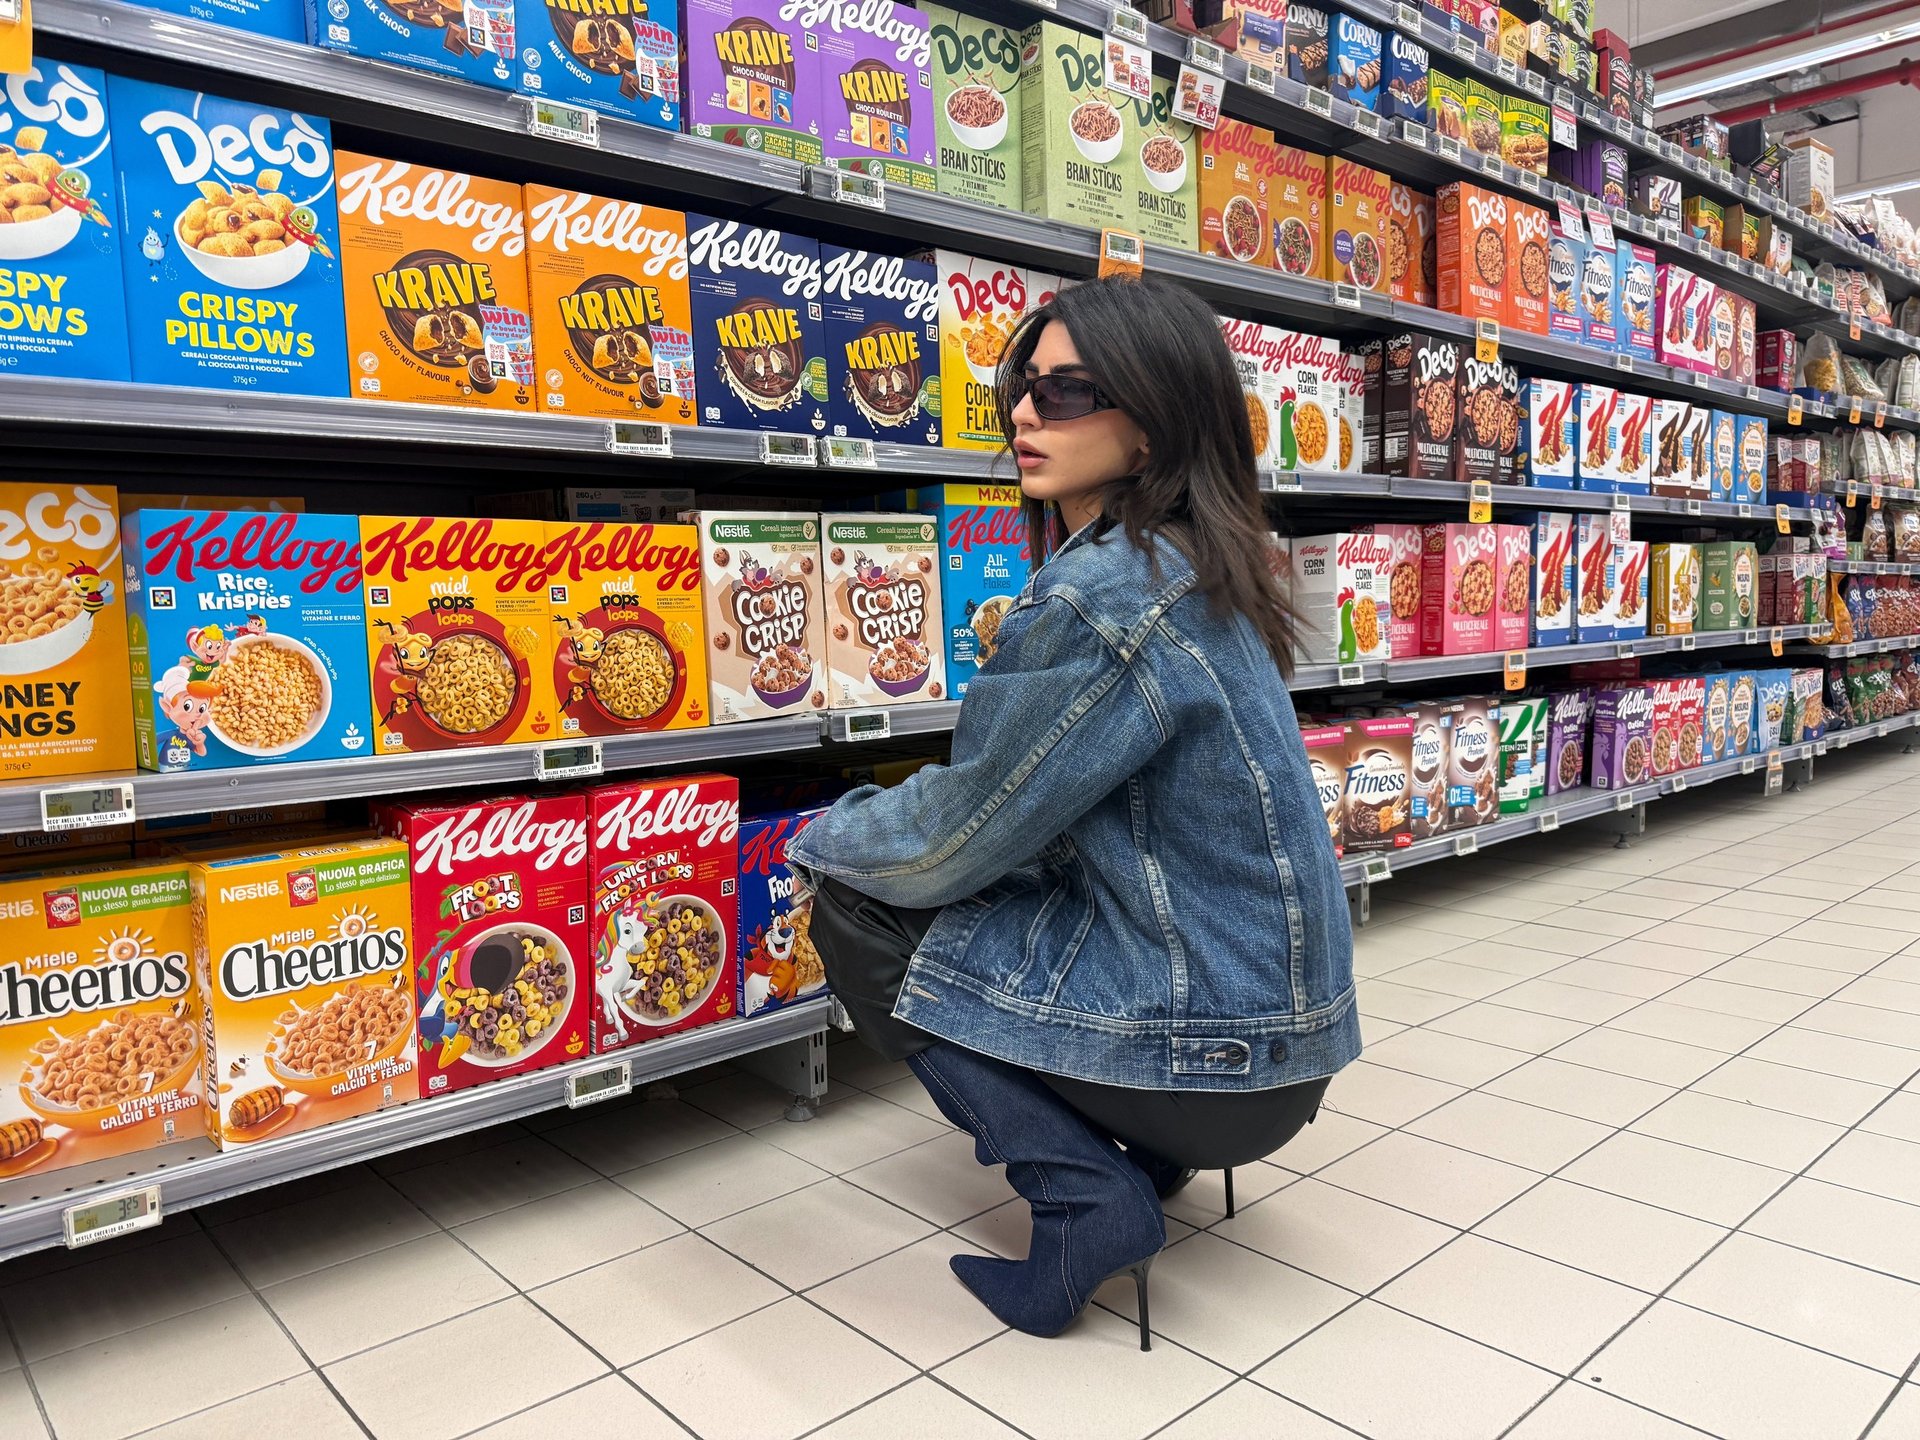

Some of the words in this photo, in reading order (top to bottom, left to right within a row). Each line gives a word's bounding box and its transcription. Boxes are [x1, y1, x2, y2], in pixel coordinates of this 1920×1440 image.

[1338, 16, 1380, 46] CORNY
[714, 29, 795, 66] KRAVE
[930, 24, 1020, 75] Decò
[1392, 33, 1427, 60] CORNY
[839, 70, 910, 103] KRAVE
[1506, 96, 1527, 112] NATURE
[1528, 103, 1548, 120] VALLEY
[140, 110, 330, 185] Decò
[941, 147, 969, 173] BRAN
[971, 153, 1006, 181] STICKS
[1066, 161, 1095, 184] BRAN
[1096, 166, 1122, 192] STICKS
[1234, 171, 1251, 183] Bran
[1283, 192, 1299, 204] Bran
[1334, 162, 1392, 216] Kellogg
[339, 161, 526, 257] Kellogg
[1138, 191, 1159, 213] BRAN
[1160, 194, 1187, 219] STICKS
[1467, 194, 1507, 230] Decò
[530, 194, 688, 281] Kellogg
[1514, 209, 1549, 244] Decò
[689, 220, 821, 299] Kellogg
[374, 263, 496, 311] KRAVE
[824, 250, 938, 321] Kellogg
[1582, 260, 1612, 288] Fitness
[1623, 269, 1652, 298] Fitness
[948, 268, 1026, 321] Decò
[178, 291, 298, 328] CRISPY
[559, 287, 664, 333] KRAVE
[165, 319, 315, 358] PILLOWS
[715, 308, 802, 349] KRAVE
[181, 351, 209, 361] CEREALI
[209, 353, 248, 363] CROCCANTI
[248, 356, 272, 366] RIPIENI
[272, 358, 280, 366] DI
[280, 359, 303, 368] CREMA
[379, 329, 400, 357] CHOCO
[399, 353, 416, 370] NUT
[416, 365, 451, 383] FLAVOUR
[845, 331, 921, 369] KRAVE
[1277, 331, 1340, 384] Kellogg
[1418, 343, 1456, 382] Decò
[563, 349, 582, 374] CHOCO
[581, 371, 595, 385] NUT
[595, 382, 624, 399] FLAVOUR
[1237, 360, 1258, 376] CORN
[1297, 370, 1318, 386] CORN
[729, 376, 746, 394] COOKIES
[748, 392, 761, 401] CREAM
[1297, 384, 1318, 396] FLAKES
[780, 524, 802, 533] integrali
[895, 526, 919, 536] integrali
[145, 511, 363, 594] Kellogg
[364, 517, 551, 593] Kellogg
[546, 522, 702, 591] Kellogg
[1338, 534, 1391, 575] Kellogg
[1454, 528, 1496, 566] Decò
[1503, 527, 1530, 565] Decò
[984, 566, 1009, 578] Bran
[1304, 559, 1325, 569] CORN
[1304, 567, 1325, 576] FLAKES
[1355, 568, 1372, 581] CORN
[217, 573, 268, 592] Rice
[430, 575, 472, 596] miel
[601, 575, 637, 594] miel
[984, 579, 1011, 589] Flakes
[1355, 581, 1372, 590] FLAKES
[198, 592, 292, 612] Krispies
[427, 596, 475, 615] pops
[600, 594, 640, 612] pops
[736, 585, 805, 625] Cookie
[852, 582, 923, 619] Cookie
[436, 612, 475, 627] loops
[608, 609, 639, 622] loops
[863, 609, 919, 644] CRISP
[745, 613, 804, 653] CRISP
[953, 628, 974, 638] 50%
[1616, 688, 1654, 721] Kellogg
[1761, 681, 1787, 702] Decò
[1440, 717, 1449, 726] NEW
[1488, 709, 1498, 719] NEW
[1554, 694, 1587, 725] Kellogg
[1655, 711, 1671, 720] Oaties
[1681, 706, 1697, 716] Oaties
[1366, 724, 1386, 732] NUOVA
[1386, 722, 1411, 731] RICETTA
[1455, 726, 1488, 748] Fitness
[1563, 723, 1578, 733] Oaties
[1627, 720, 1645, 730] Oaties
[1421, 756, 1437, 765] Protein
[1467, 748, 1485, 757] Protein
[1344, 764, 1406, 796] Fitness
[1369, 766, 1386, 774] Cioccolato
[1387, 762, 1406, 771] Fondente
[596, 784, 740, 850] Kellogg
[415, 802, 588, 875] Kellogg
[318, 866, 356, 882] NUOVA
[358, 858, 406, 876] GRAFICA
[325, 883, 335, 893] Lo
[336, 878, 357, 891] stesso
[360, 877, 376, 888] gusto
[376, 873, 401, 884] delizioso
[604, 852, 679, 890] UNICORN
[82, 886, 127, 903] NUOVA
[131, 879, 188, 897] GRAFICA
[451, 874, 515, 912] FROOT
[601, 877, 647, 911] FROOT
[651, 863, 693, 885] LOOPS
[89, 904, 101, 915] Lo
[103, 900, 129, 911] stesso
[132, 898, 151, 909] gusto
[152, 893, 181, 904] delizioso
[271, 928, 315, 947] Miele
[26, 952, 78, 971] Miele
[222, 929, 404, 999] Cheerios
[331, 1077, 367, 1096] CALCIO
[371, 1073, 378, 1083] E
[380, 1060, 412, 1079] FERRO
[346, 1055, 396, 1080] VITAMINE
[100, 1111, 144, 1131] CALCIO
[149, 1106, 157, 1118] E
[160, 1094, 198, 1113] FERRO
[117, 1089, 179, 1114] VITAMINE
